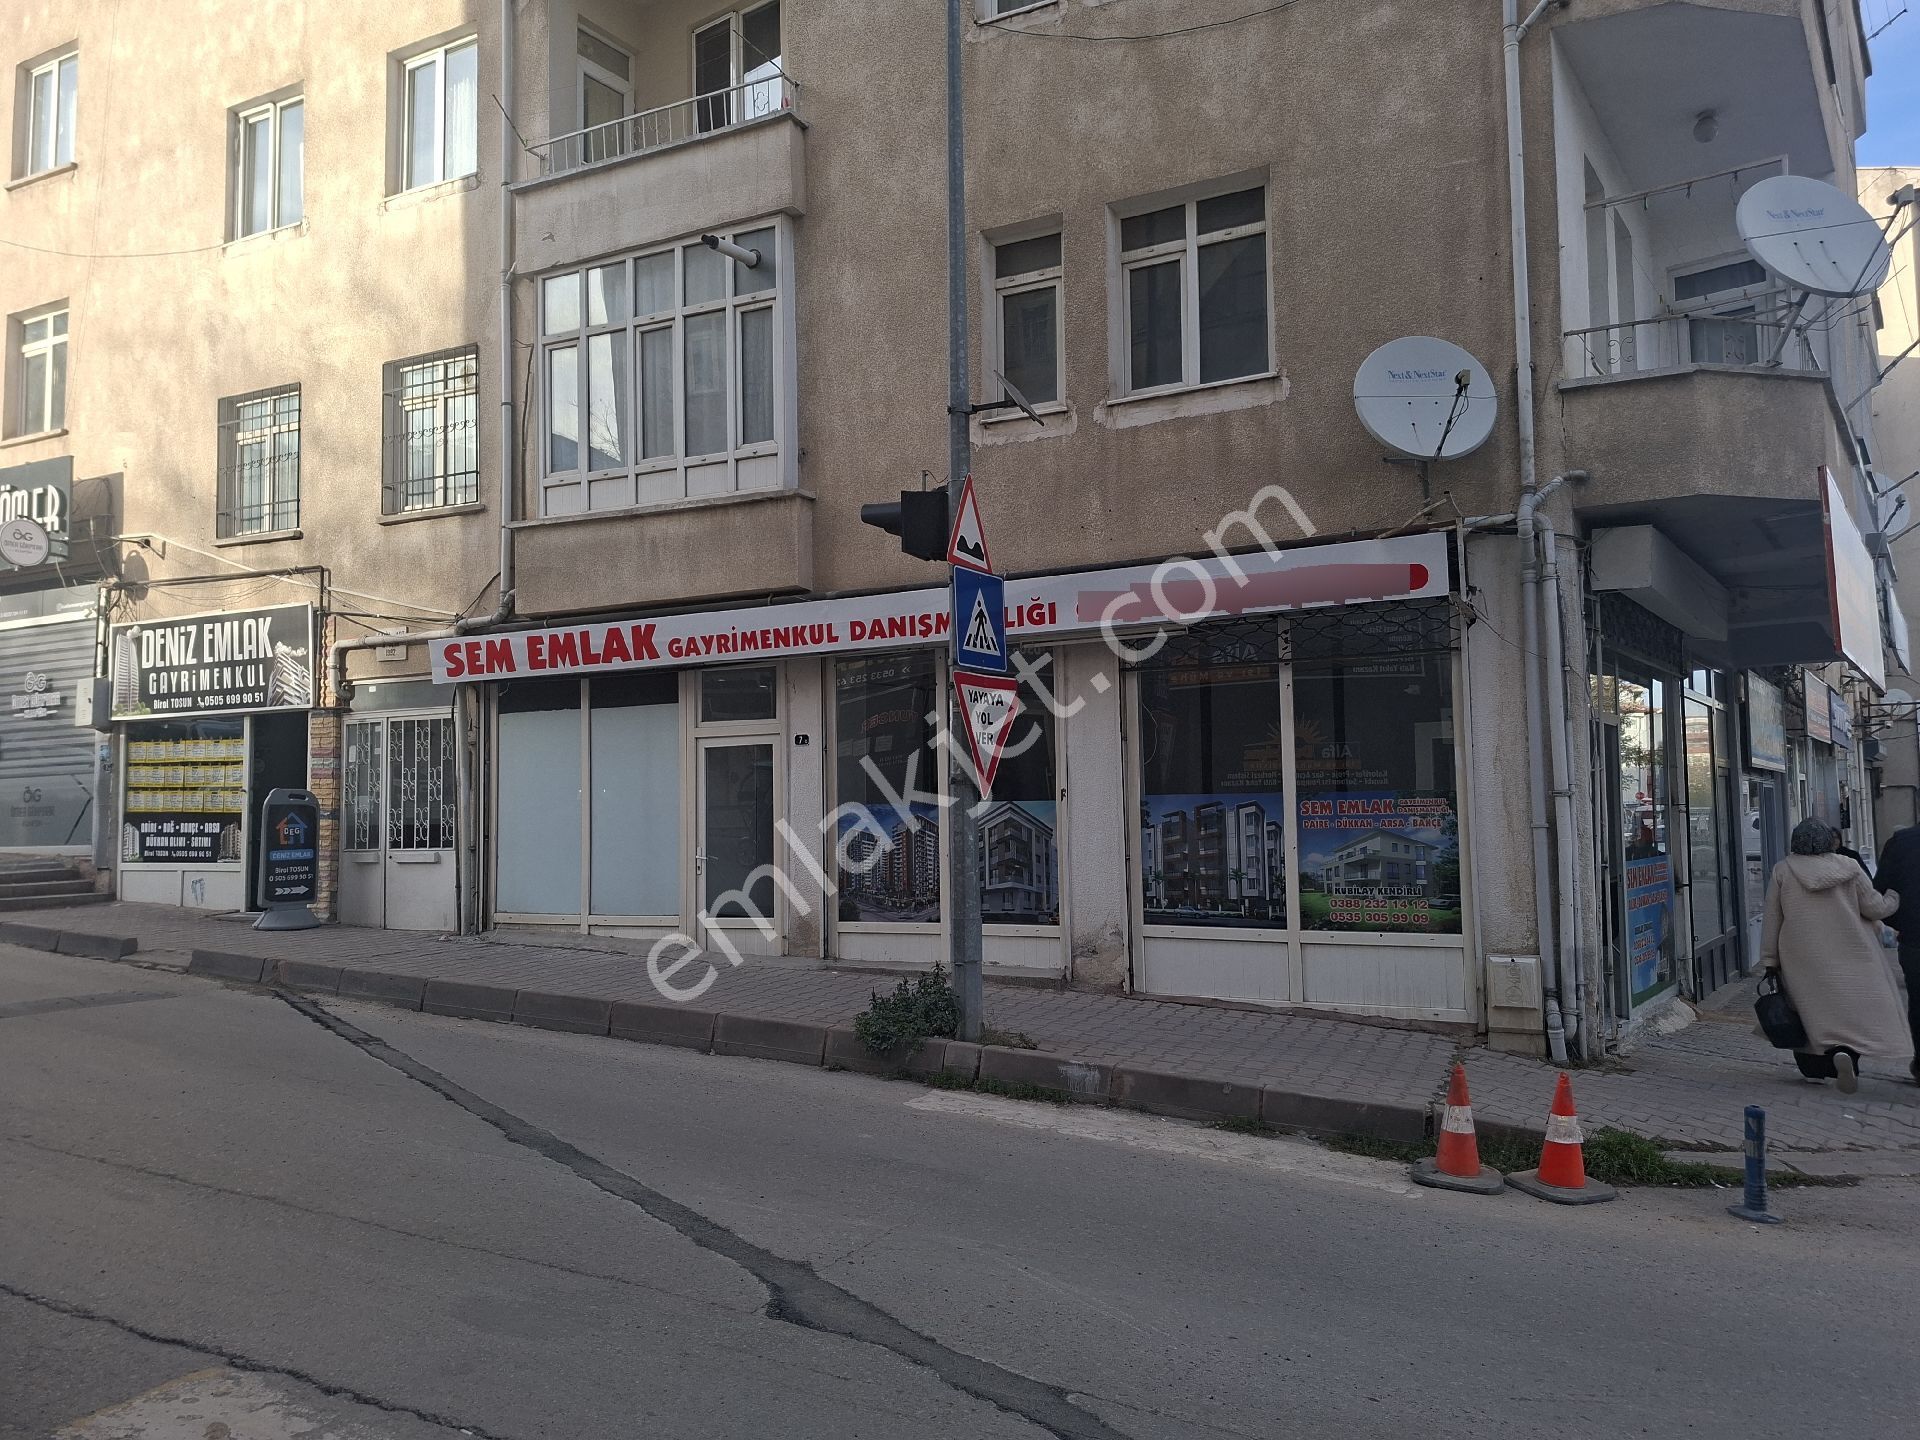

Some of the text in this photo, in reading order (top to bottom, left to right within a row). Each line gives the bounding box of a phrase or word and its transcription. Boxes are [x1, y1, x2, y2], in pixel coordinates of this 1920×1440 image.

[203, 616, 274, 664] EMLAK
[443, 596, 1057, 678] SEM EMLAK GAYRİMENKUL DANIŞMLIĞI
[153, 697, 169, 710] Birol
[171, 696, 192, 709] TOSUN
[204, 695, 224, 707] 0505
[226, 693, 241, 705] 699
[254, 691, 264, 703] 51
[968, 689, 1004, 707] YAYAYA
[975, 711, 994, 726] YOL
[975, 731, 995, 746] VER
[1300, 799, 1333, 816] SEM
[1337, 799, 1395, 815] EMLAK
[1303, 816, 1442, 830] DAİRE DÜKKAN ARSA BAHÇE
[284, 827, 300, 836] DEG
[289, 865, 309, 873] TOSUN
[1334, 884, 1423, 897] KUBİLAY KENDİRLİ
[1330, 899, 1429, 911] 0388 232 14 12
[1330, 912, 1430, 924] 0535 305 99 09
